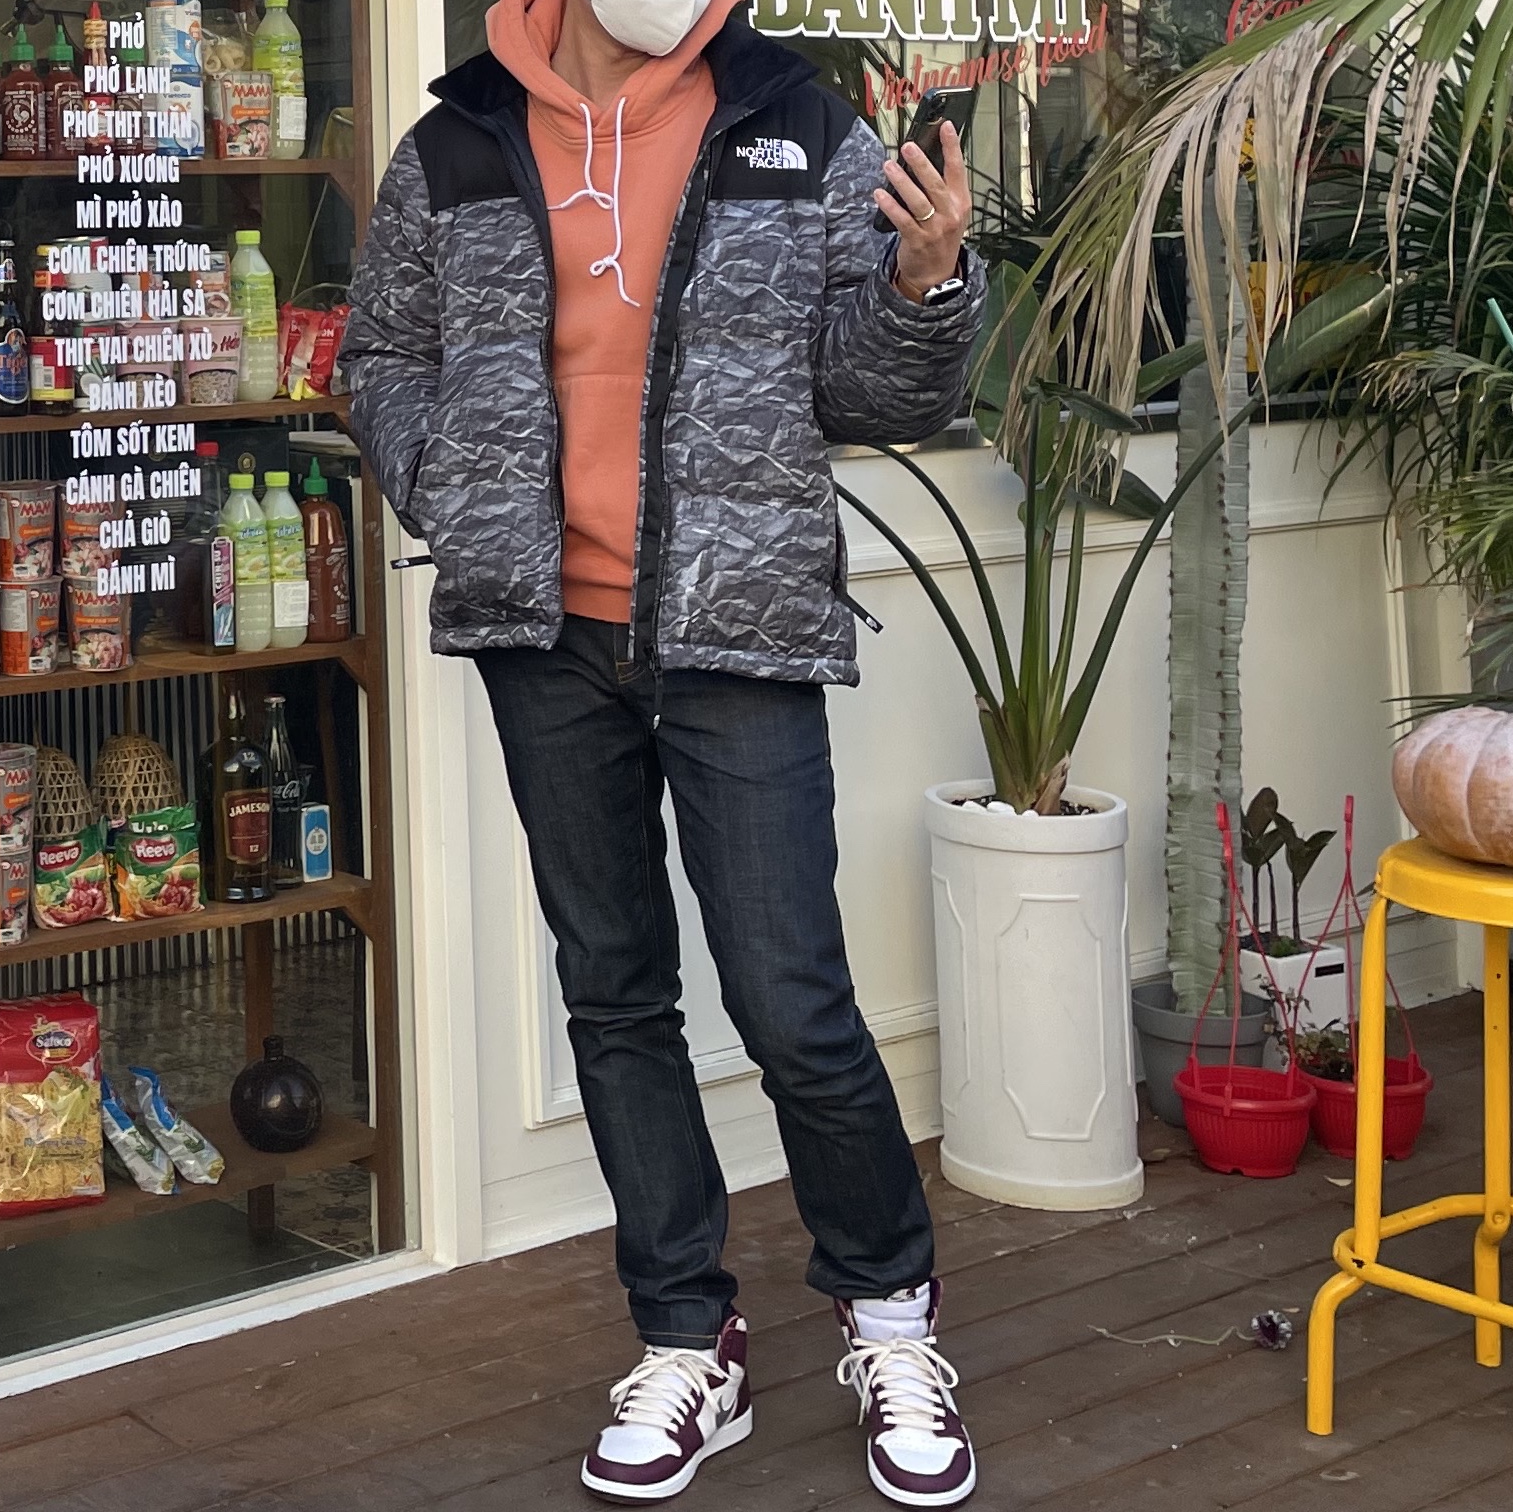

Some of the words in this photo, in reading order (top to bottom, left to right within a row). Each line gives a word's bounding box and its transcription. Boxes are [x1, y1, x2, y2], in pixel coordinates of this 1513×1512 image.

[109, 11, 145, 49] PHỞ
[84, 55, 119, 93] PHỞ
[125, 66, 171, 99] LẠNH
[864, 42, 1032, 116] Vietnamese
[1040, 2, 1107, 87] food
[63, 100, 99, 138] PHỞ
[105, 110, 142, 144] THỊT
[736, 146, 782, 158] NORTH
[755, 138, 782, 148] THE
[78, 146, 114, 183] PHỞ
[119, 155, 180, 183] XƯƠNG
[749, 158, 783, 169] FACE
[76, 193, 101, 229] MÌ
[106, 190, 142, 228] PHỞ
[147, 193, 183, 227] XÀO
[48, 244, 90, 274] CƠM
[96, 238, 148, 273] CHIÊN
[153, 239, 211, 272] TRỨNG
[42, 290, 85, 321] CƠM
[91, 283, 142, 319] CHIÊN
[148, 280, 177, 317] HẢI
[182, 280, 206, 316] SẢ
[55, 337, 93, 372] THỊT
[99, 336, 128, 364] VAI
[133, 327, 184, 363] CHIÊN
[190, 326, 213, 360] XÙ
[88, 377, 137, 411] BÁNH
[143, 373, 176, 407] XÈO
[70, 422, 112, 459] TÔM
[117, 419, 151, 456] SỐT
[155, 423, 196, 453] KEM
[66, 468, 115, 505] CÁNH
[120, 465, 145, 501] GÀ
[150, 462, 201, 498] CHIÊN
[99, 510, 138, 549] CHẢ
[141, 507, 171, 546] GIÒ
[97, 560, 147, 597] BÁNH
[151, 555, 176, 591] MÌ
[242, 752, 256, 762] 12
[39, 845, 80, 866] Reeva
[136, 841, 175, 859] Reeva
